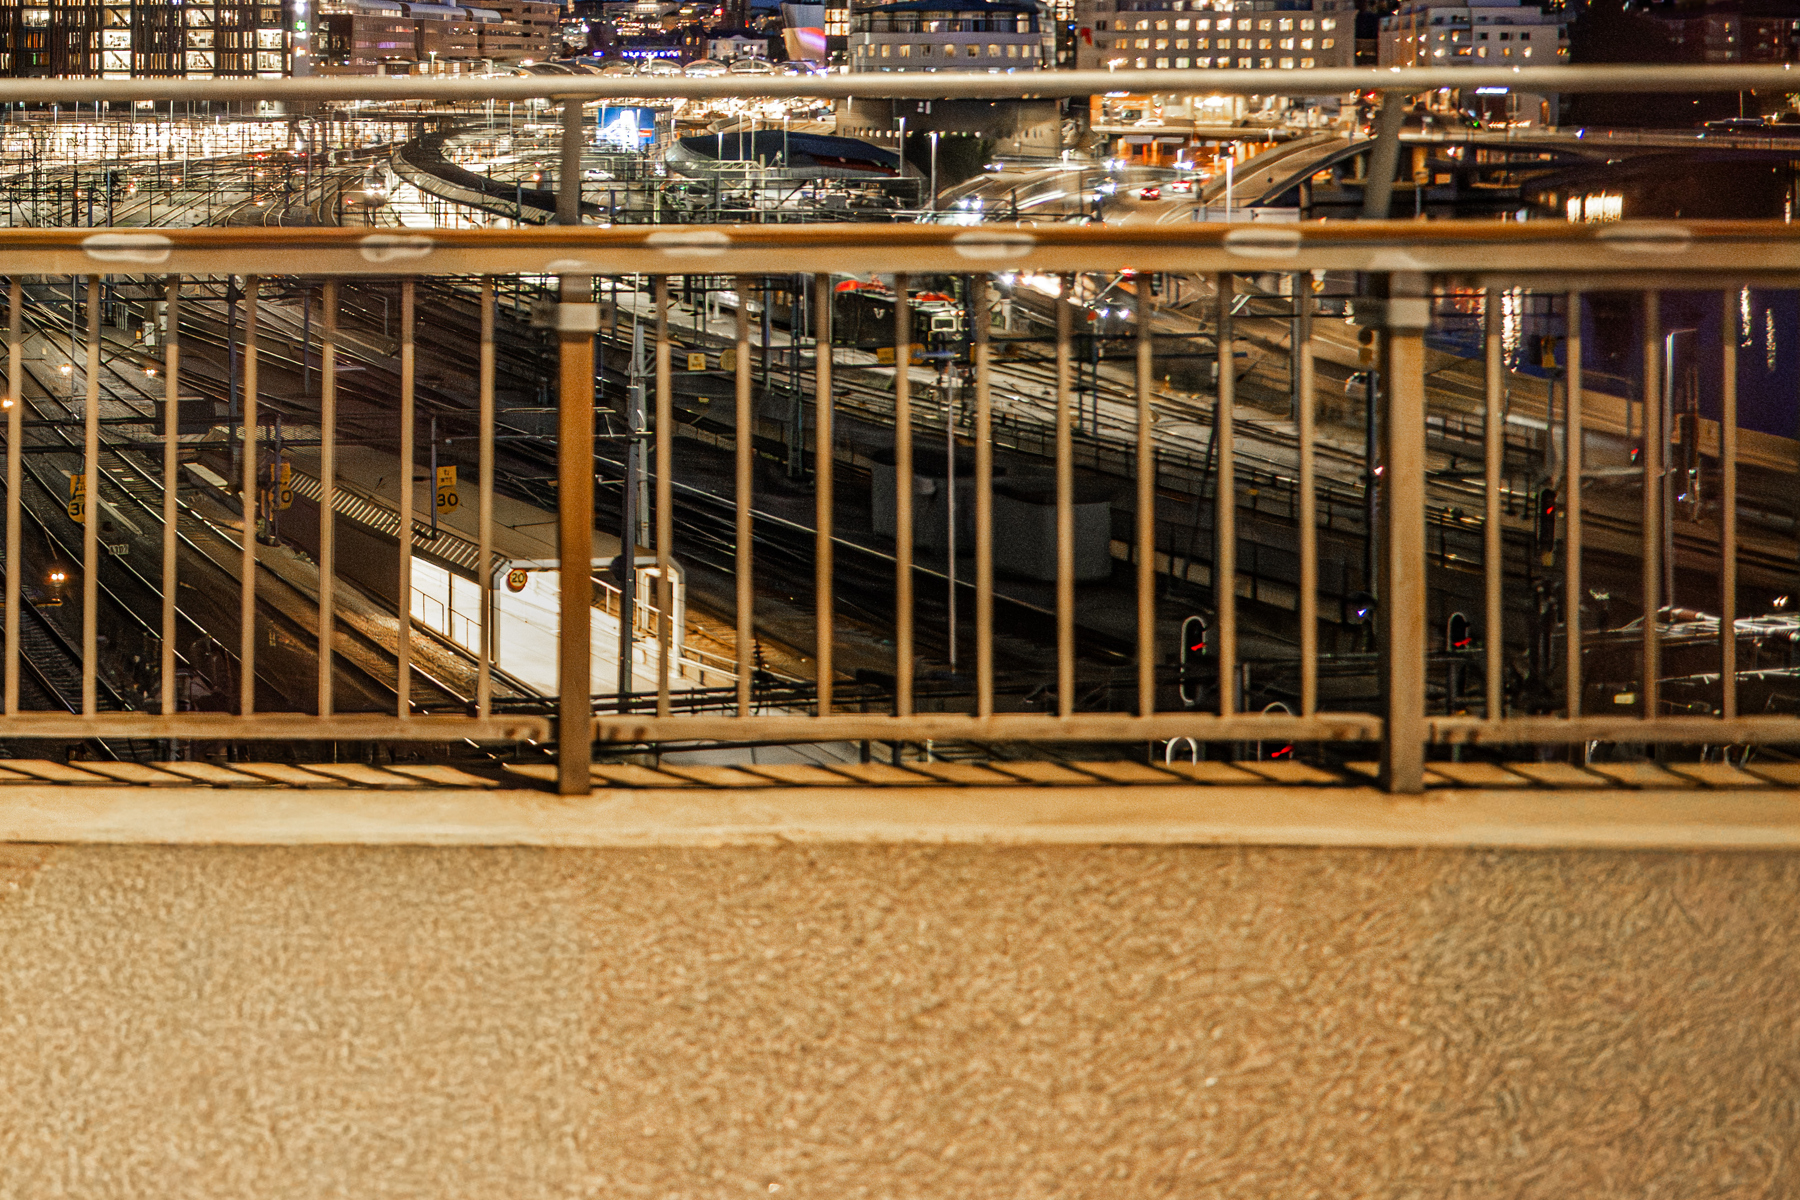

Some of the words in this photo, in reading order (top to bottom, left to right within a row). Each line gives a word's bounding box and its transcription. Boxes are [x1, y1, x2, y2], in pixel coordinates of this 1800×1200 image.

[437, 493, 459, 507] 30
[69, 503, 85, 516] 3
[511, 573, 525, 583] 20
